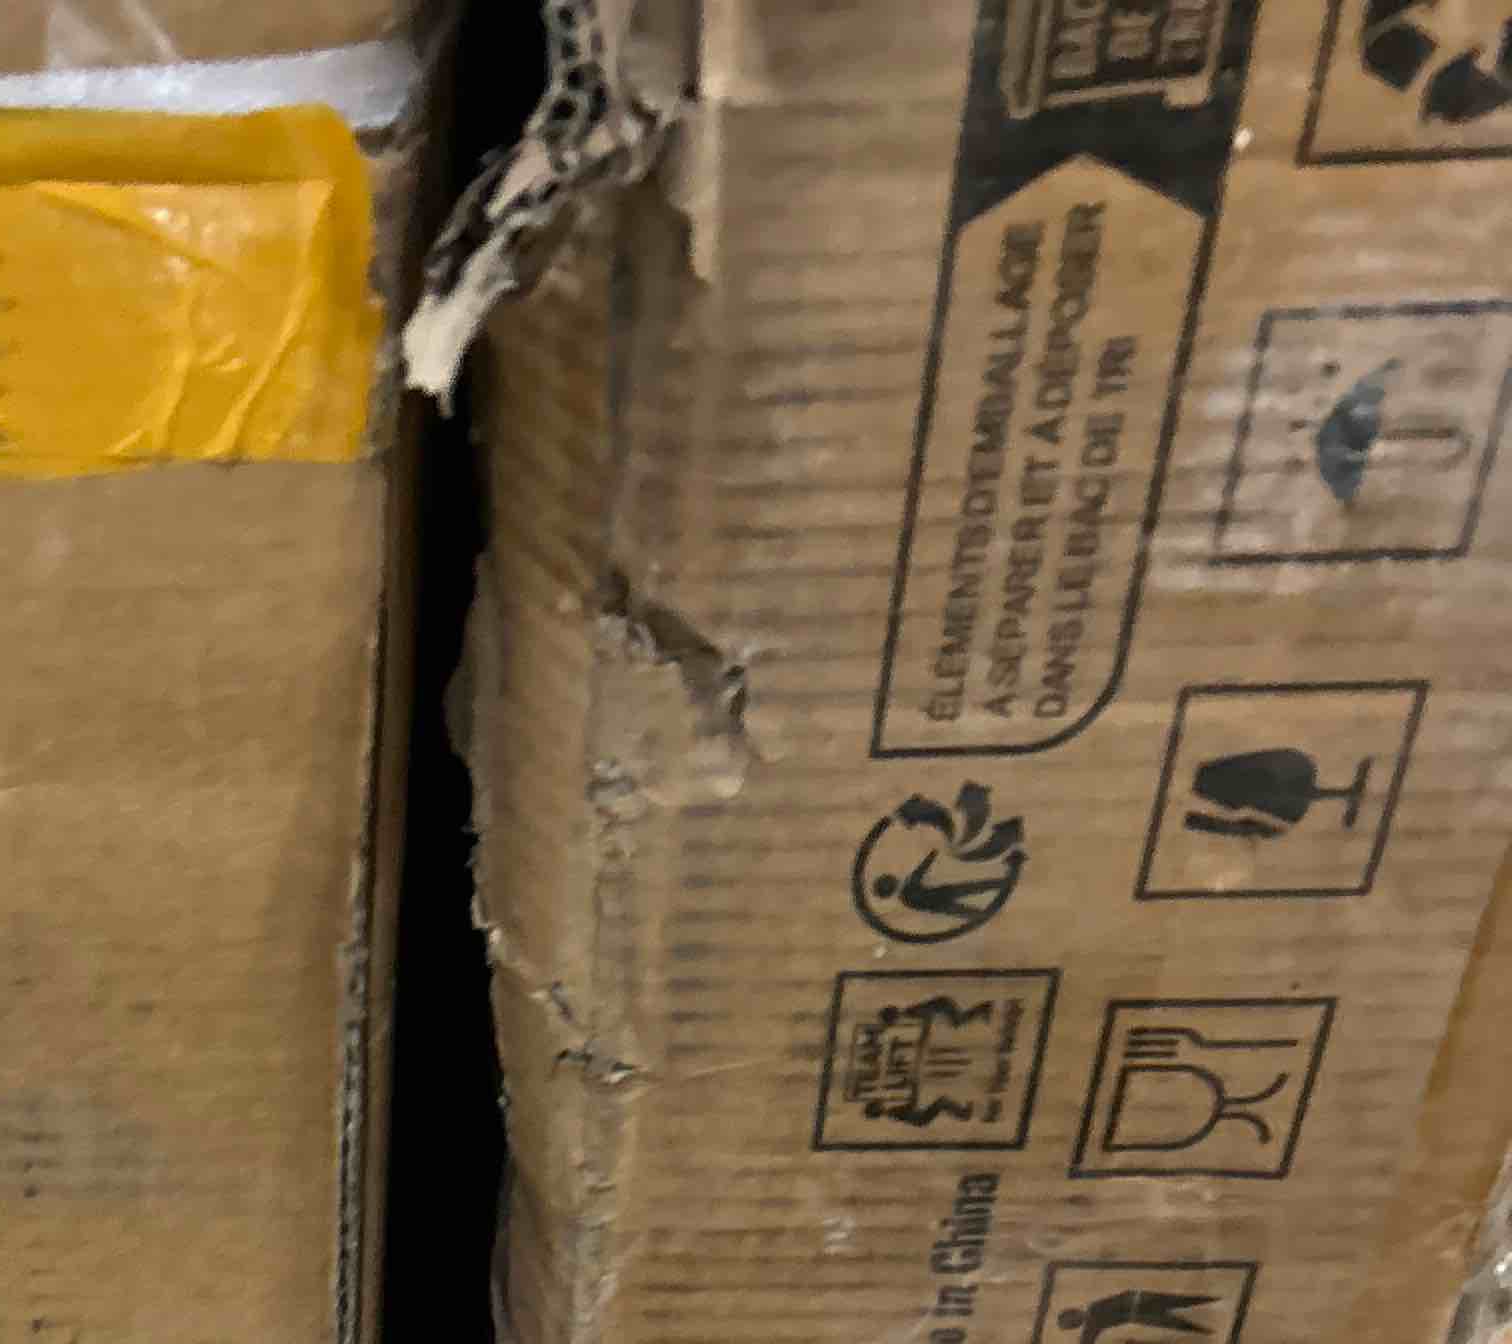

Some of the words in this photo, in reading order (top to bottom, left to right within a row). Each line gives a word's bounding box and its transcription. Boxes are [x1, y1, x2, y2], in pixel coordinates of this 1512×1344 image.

[1092, 334, 1141, 399] TRI
[1081, 412, 1126, 467] DE
[1020, 455, 1059, 507] ET
[1065, 475, 1112, 557] BAC
[1052, 562, 1095, 612] LE
[1033, 616, 1086, 719] DANS
[884, 1036, 914, 1091] LIFT
[929, 1172, 1001, 1274] China
[928, 1284, 979, 1317] in
